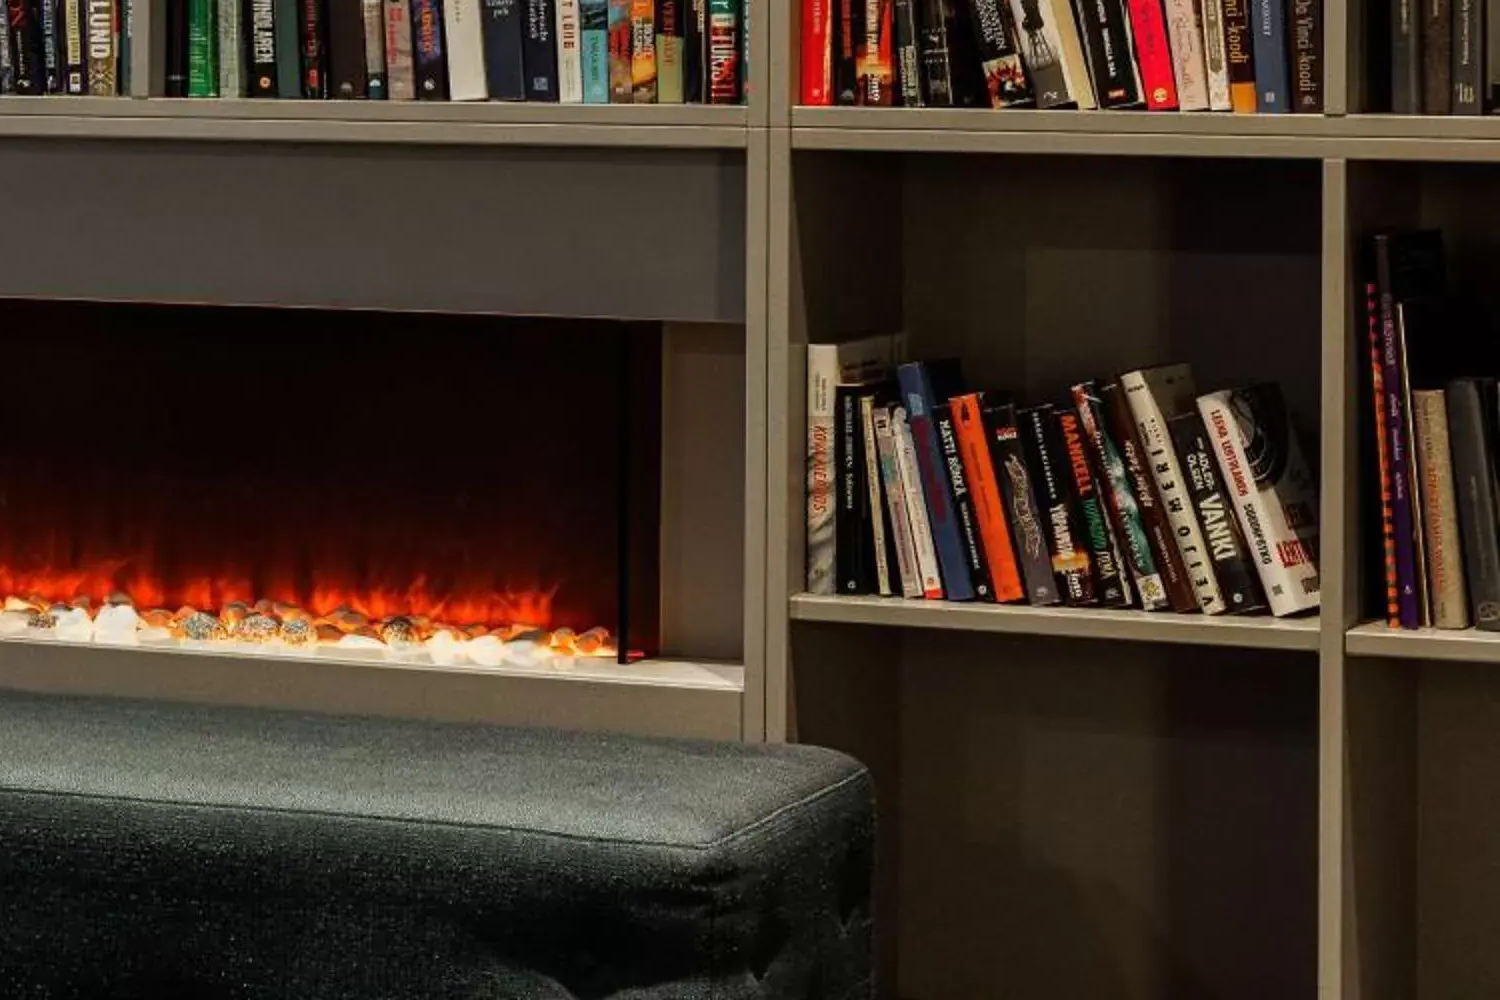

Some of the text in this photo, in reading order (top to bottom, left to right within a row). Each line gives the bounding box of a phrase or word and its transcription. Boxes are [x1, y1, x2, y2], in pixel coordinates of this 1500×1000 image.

[1226, 22, 1247, 64] -koodi
[1297, 18, 1315, 48] Vinci
[710, 35, 738, 99] TURISTI
[1299, 51, 1318, 92] -koodi
[1060, 415, 1092, 496] MANKELL
[1186, 453, 1201, 491] OLSEN
[948, 456, 967, 497] RÖNKÄ
[1151, 449, 1214, 608] VEIJO MERI
[1198, 492, 1236, 561] VANKI
[1070, 573, 1083, 597] into
